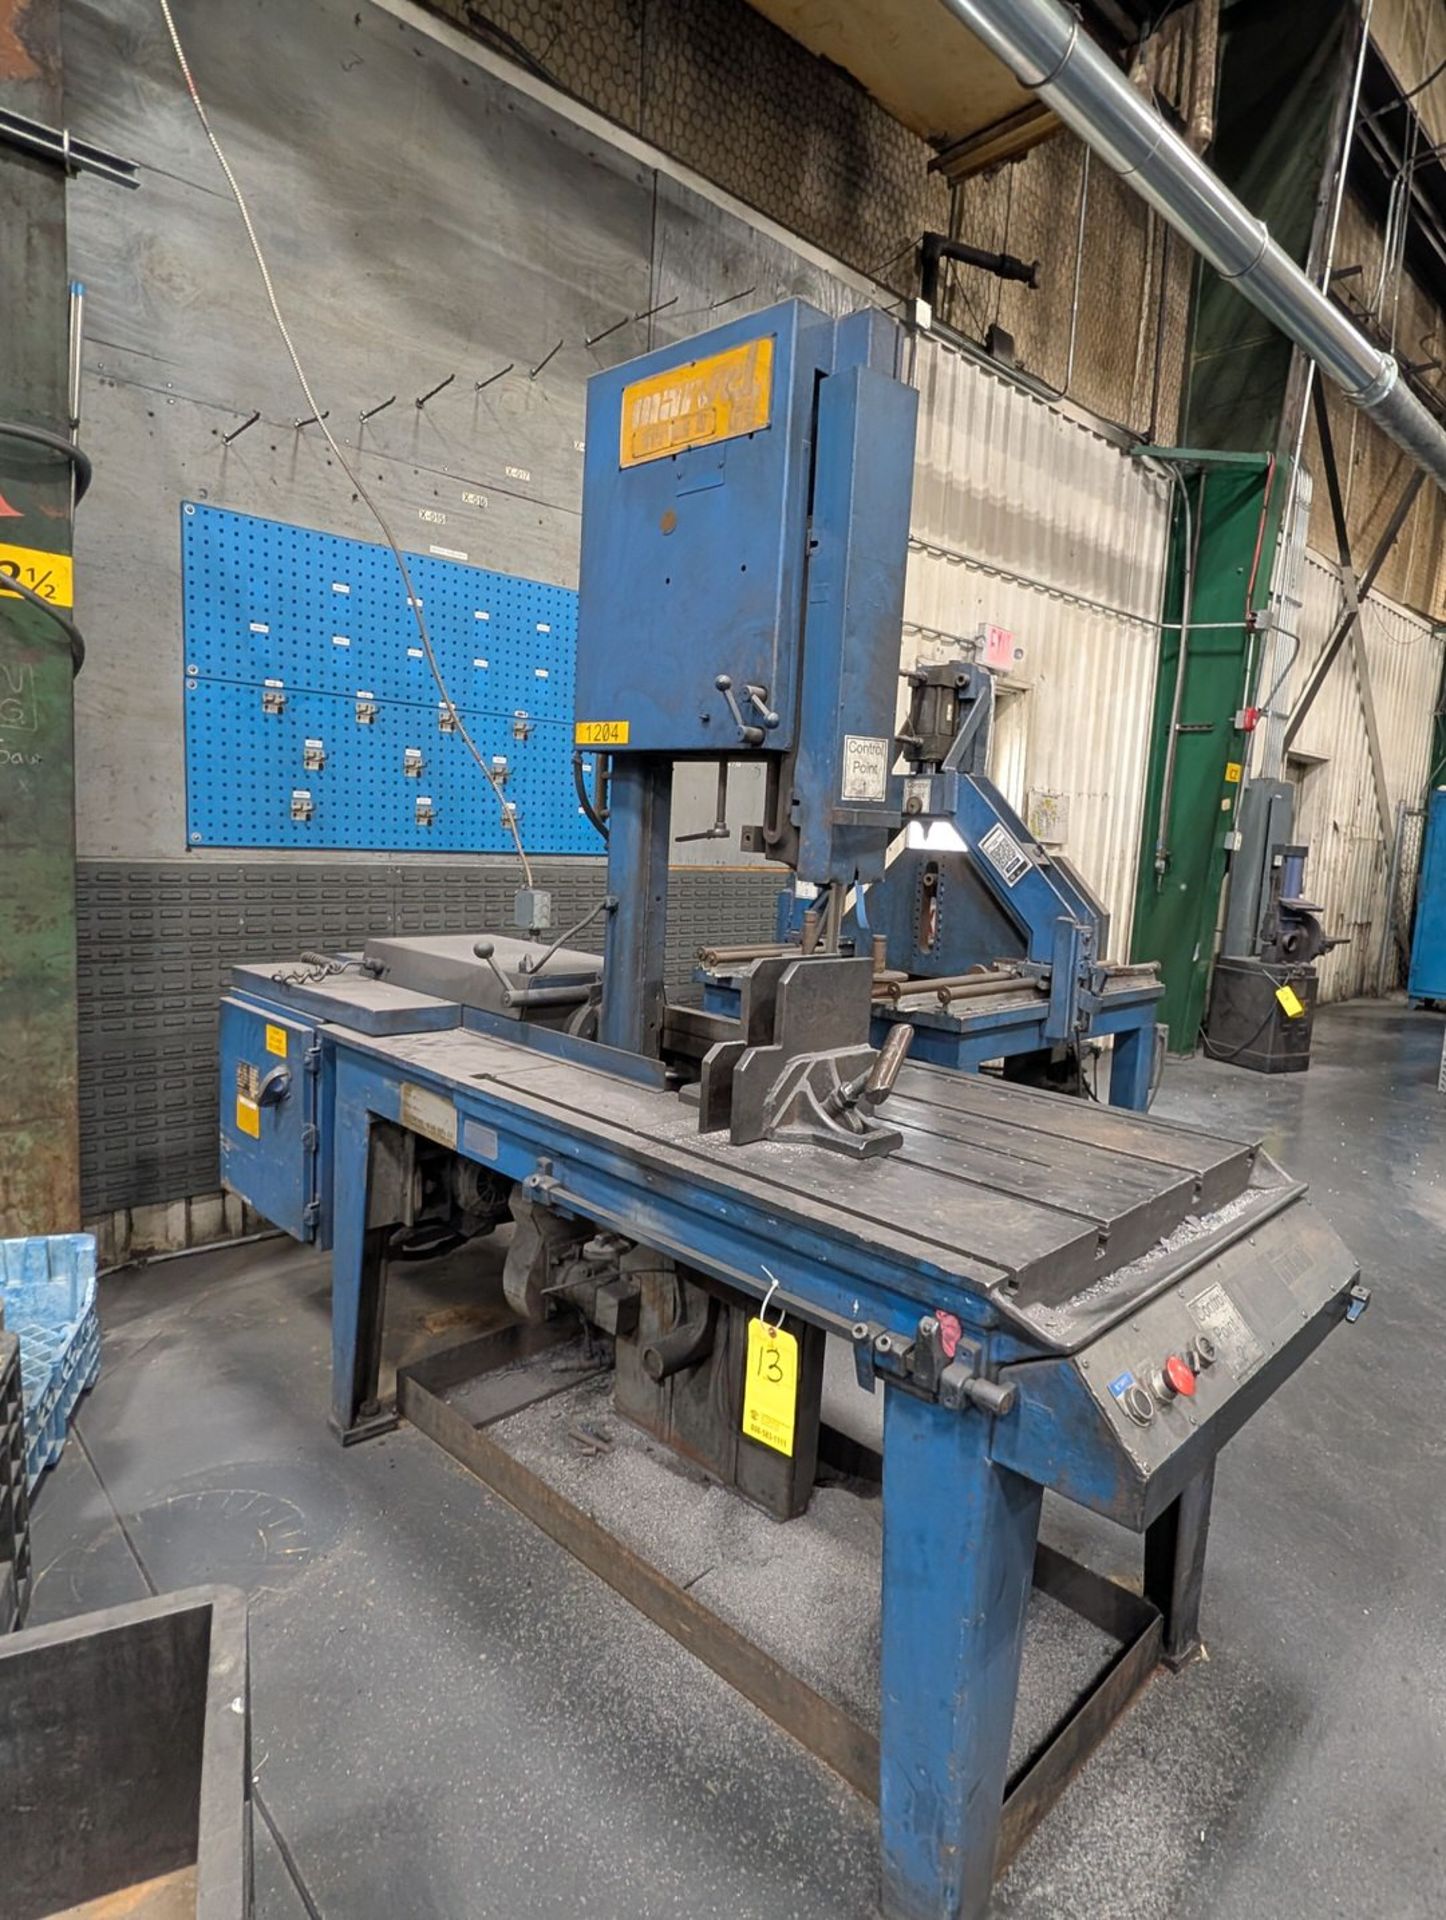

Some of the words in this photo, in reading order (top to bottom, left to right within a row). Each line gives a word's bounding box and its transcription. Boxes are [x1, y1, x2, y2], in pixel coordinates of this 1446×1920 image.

[586, 723, 619, 742] 1204
[848, 740, 885, 756] Control
[852, 761, 878, 775] Point
[757, 1346, 783, 1383] 13
